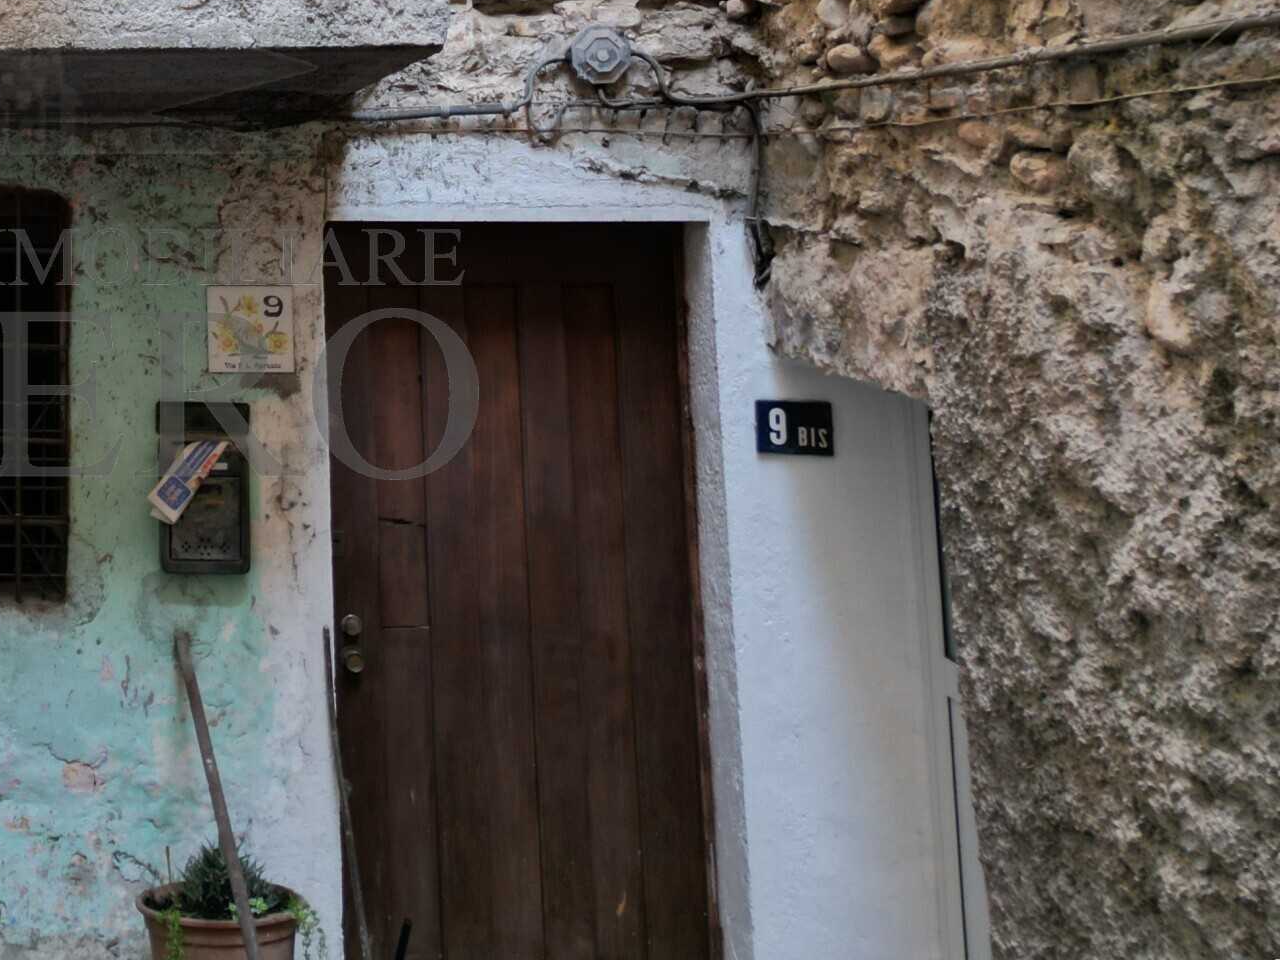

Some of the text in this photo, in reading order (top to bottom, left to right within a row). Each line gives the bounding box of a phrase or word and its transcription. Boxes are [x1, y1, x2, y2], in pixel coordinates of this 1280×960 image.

[263, 295, 284, 318] 9
[768, 407, 828, 448] 9 BIS
